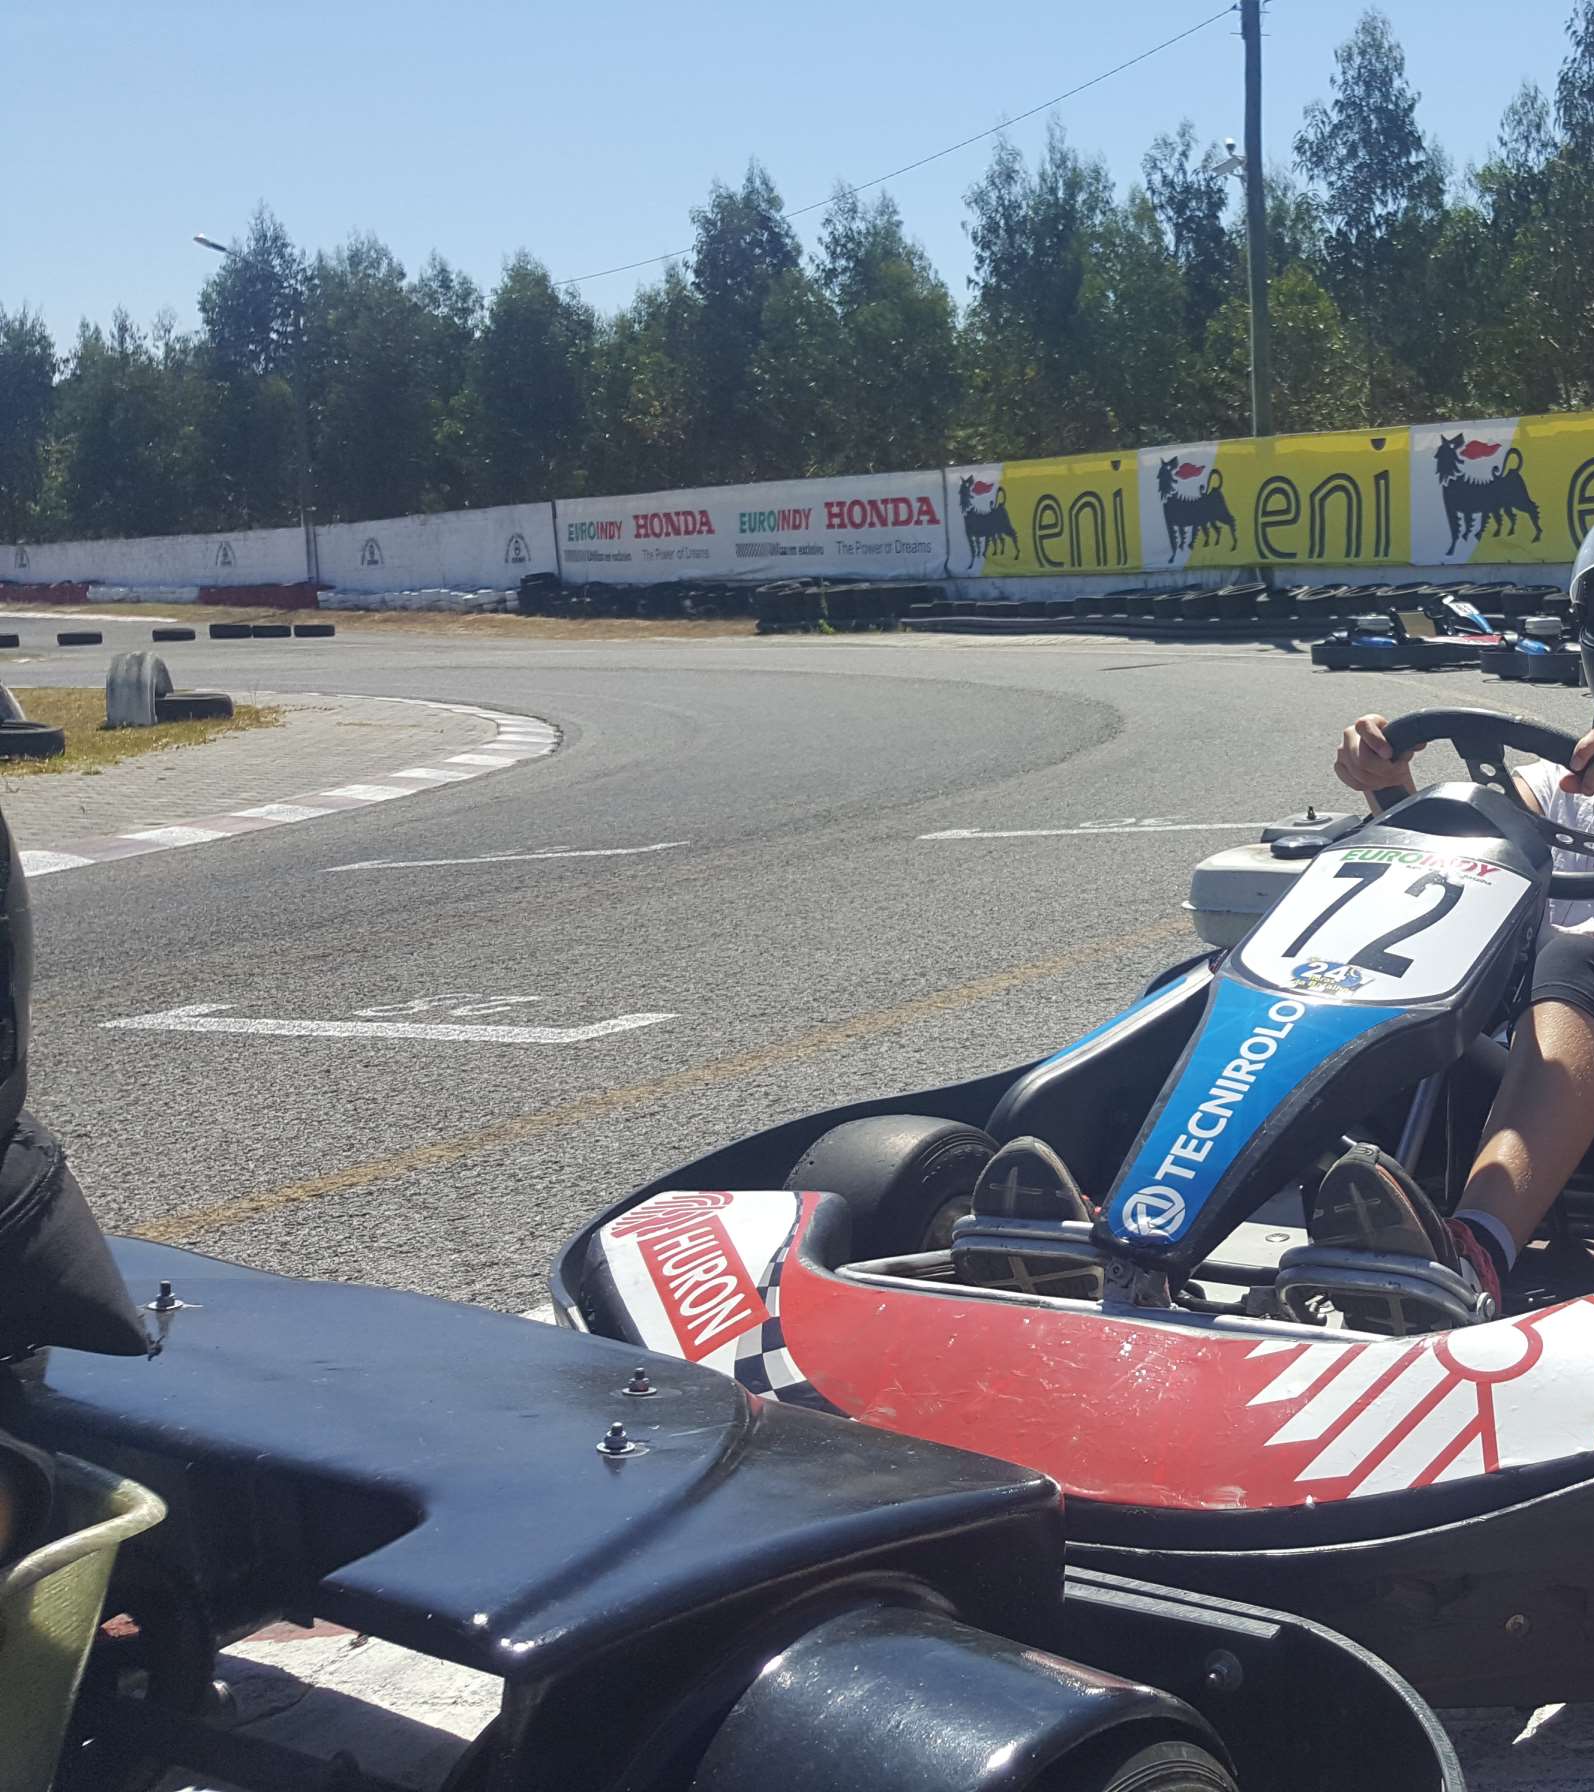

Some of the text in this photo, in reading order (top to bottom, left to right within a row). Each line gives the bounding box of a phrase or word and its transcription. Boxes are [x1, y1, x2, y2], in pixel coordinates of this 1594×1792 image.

[567, 510, 716, 542] EUROINDY HONDA
[739, 496, 941, 534] EUROINDY HONDA
[895, 539, 932, 555] Dreams
[1032, 460, 1127, 568] eni
[1254, 437, 1392, 560] eni
[1281, 862, 1465, 978] 72
[1299, 961, 1351, 982] 24
[1153, 999, 1306, 1180] TECNIROLO
[653, 1226, 752, 1346] HURON
